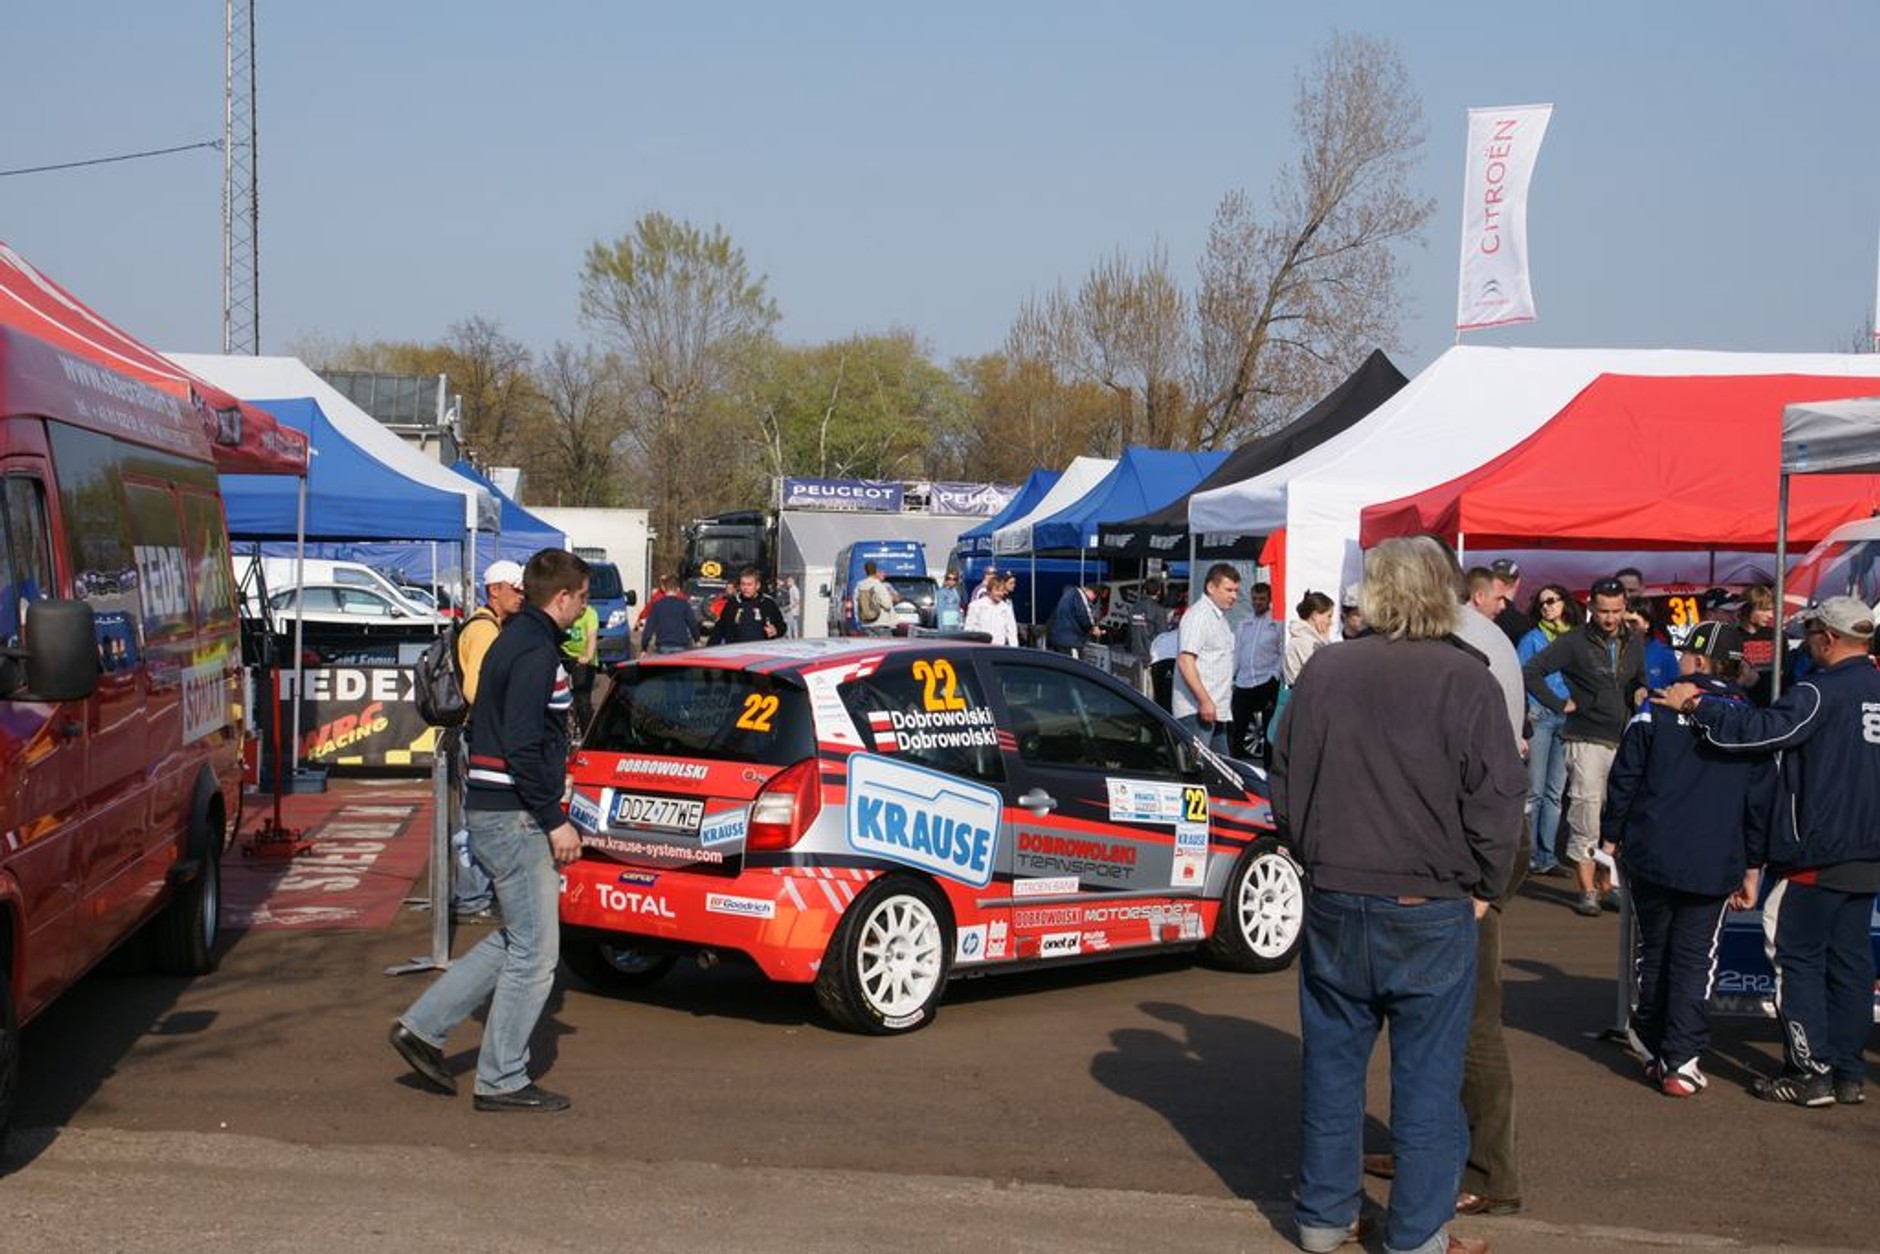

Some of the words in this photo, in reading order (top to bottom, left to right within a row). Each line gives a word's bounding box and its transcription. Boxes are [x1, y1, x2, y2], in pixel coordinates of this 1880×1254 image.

[1481, 119, 1517, 255] CITROËN
[793, 485, 894, 499] PEUGEOT
[1668, 596, 1700, 626] 31
[912, 659, 966, 712] 22
[736, 693, 780, 732] 22
[891, 706, 994, 730] Dobrowolski
[897, 727, 998, 750] Dobrowolski
[615, 757, 709, 780] DOBROWOLSKI
[571, 804, 598, 831] KRAUSE
[1186, 788, 1207, 821] 22
[702, 821, 745, 845] KRAUSE
[857, 794, 991, 872] KRAUSE
[1017, 832, 1137, 866] DOBROWOLSKI
[596, 883, 675, 918] TOTAL
[1016, 909, 1082, 927] DOBROWOLSKI
